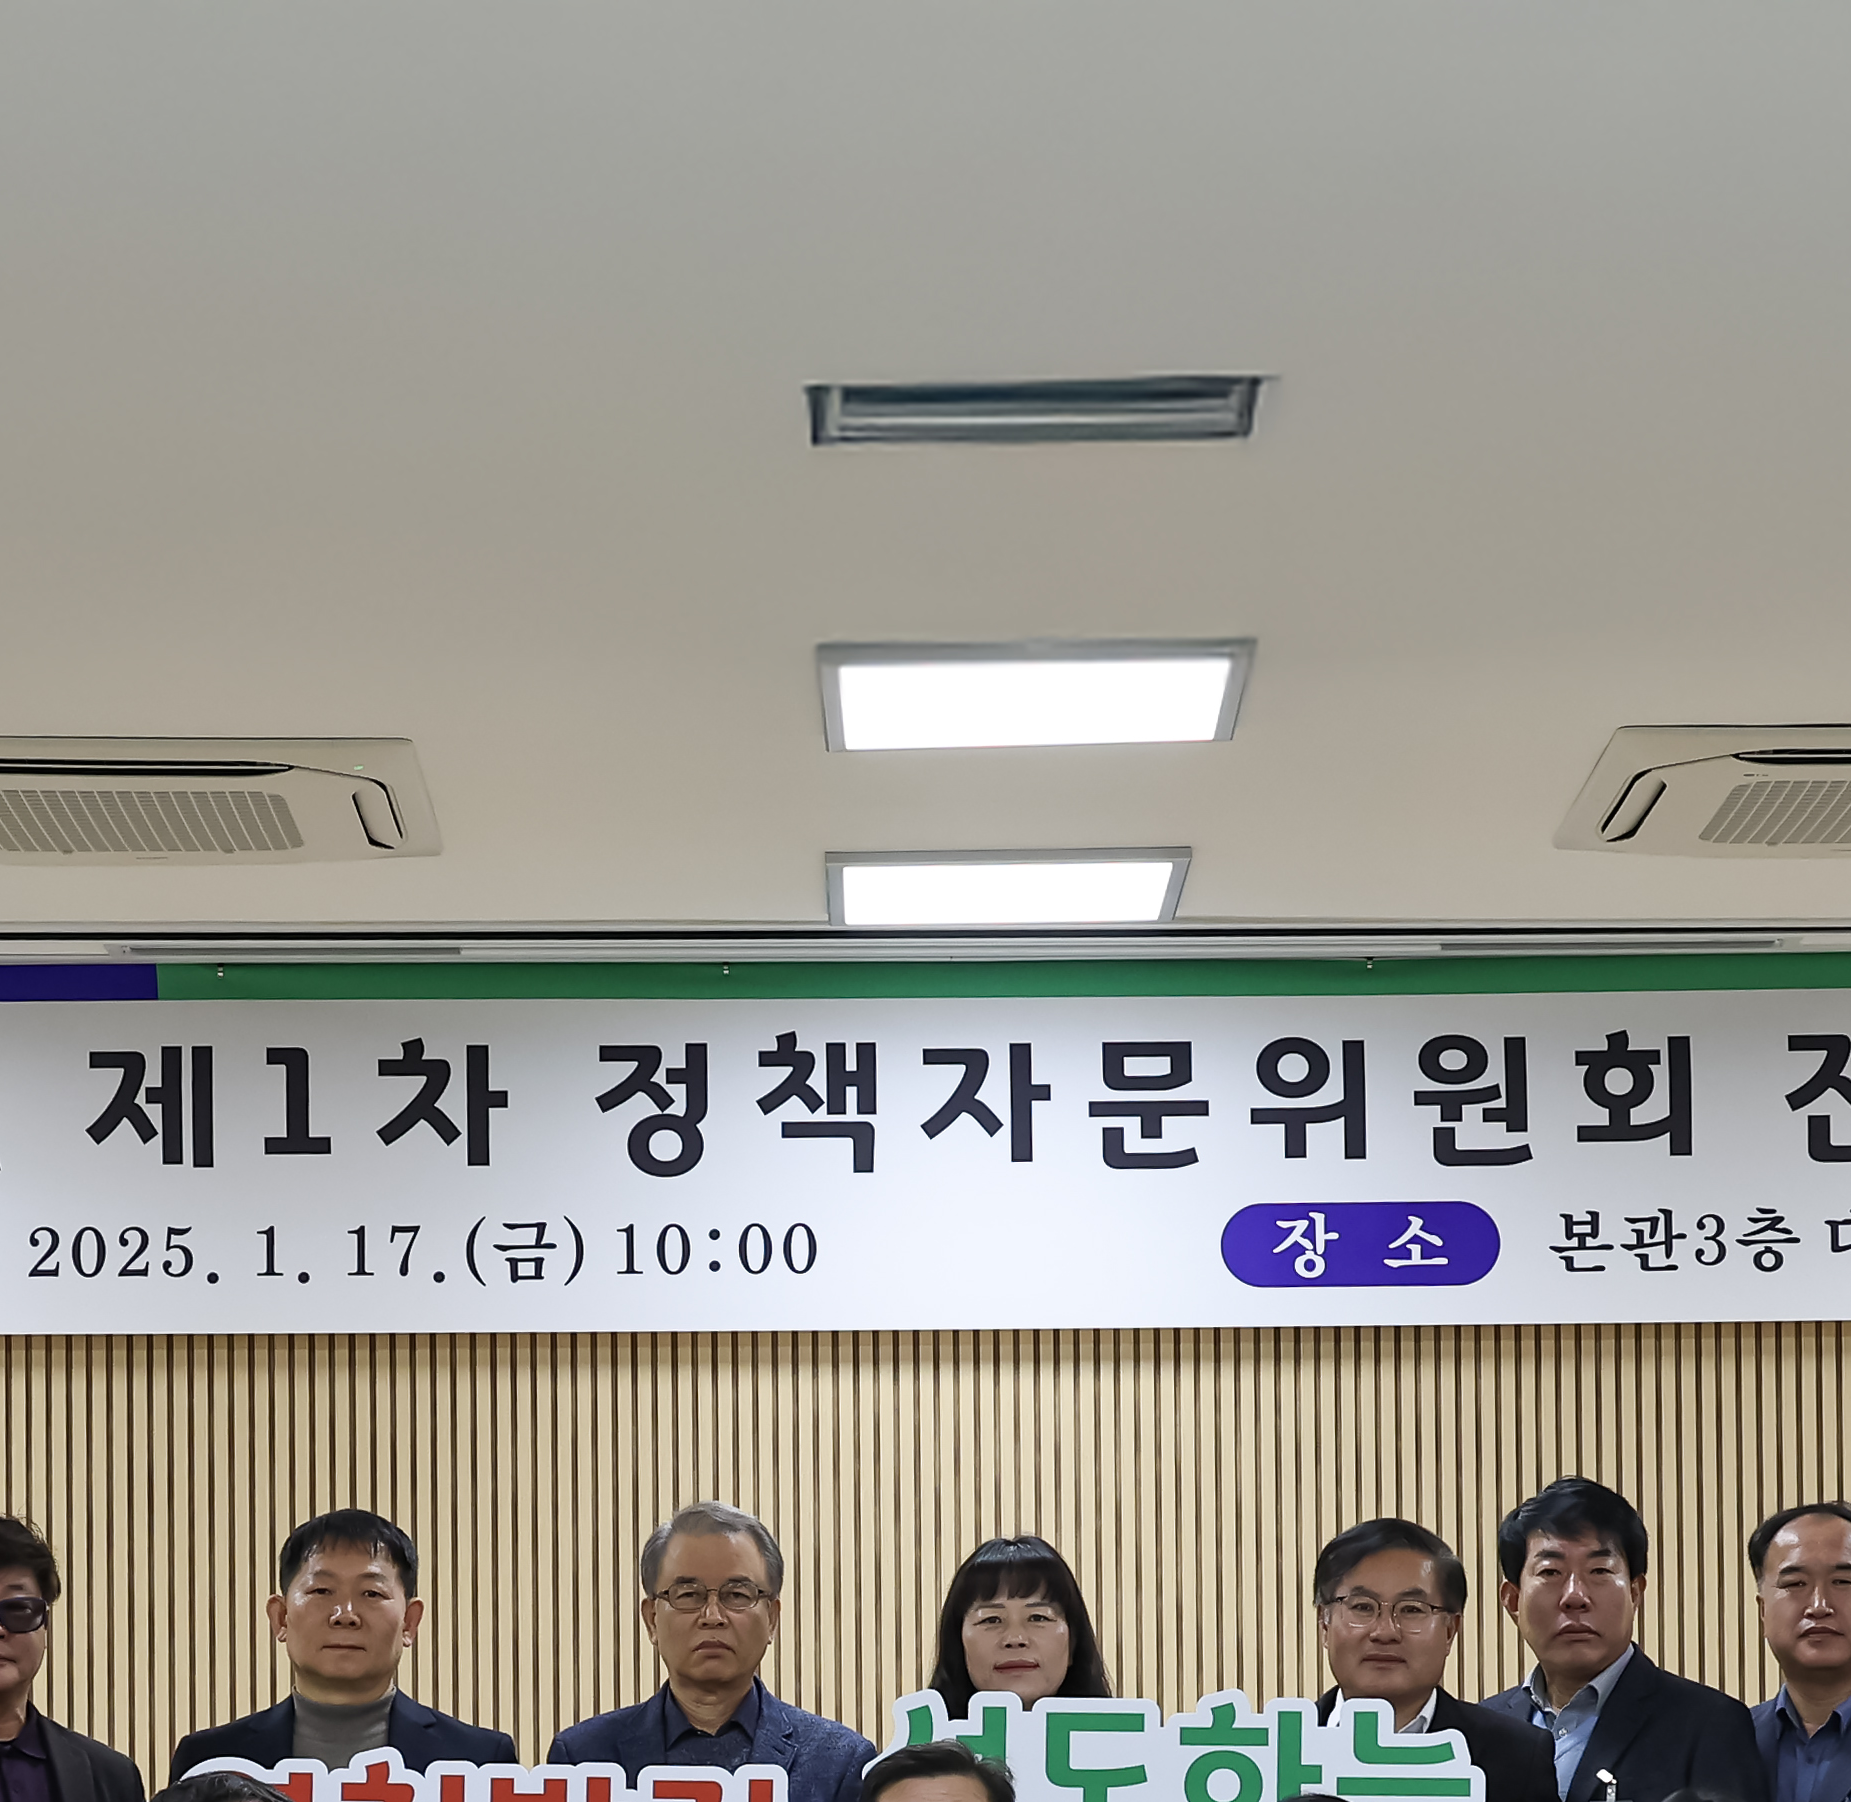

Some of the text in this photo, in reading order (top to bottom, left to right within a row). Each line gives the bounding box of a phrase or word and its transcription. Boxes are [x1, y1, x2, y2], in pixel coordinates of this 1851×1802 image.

[85, 1037, 510, 1170] 제1차
[594, 1030, 1695, 1179] 정책자문위원회
[28, 1226, 222, 1286] 2025.
[616, 1222, 819, 1277] 10:00
[1549, 1208, 1803, 1275] 본관3층
